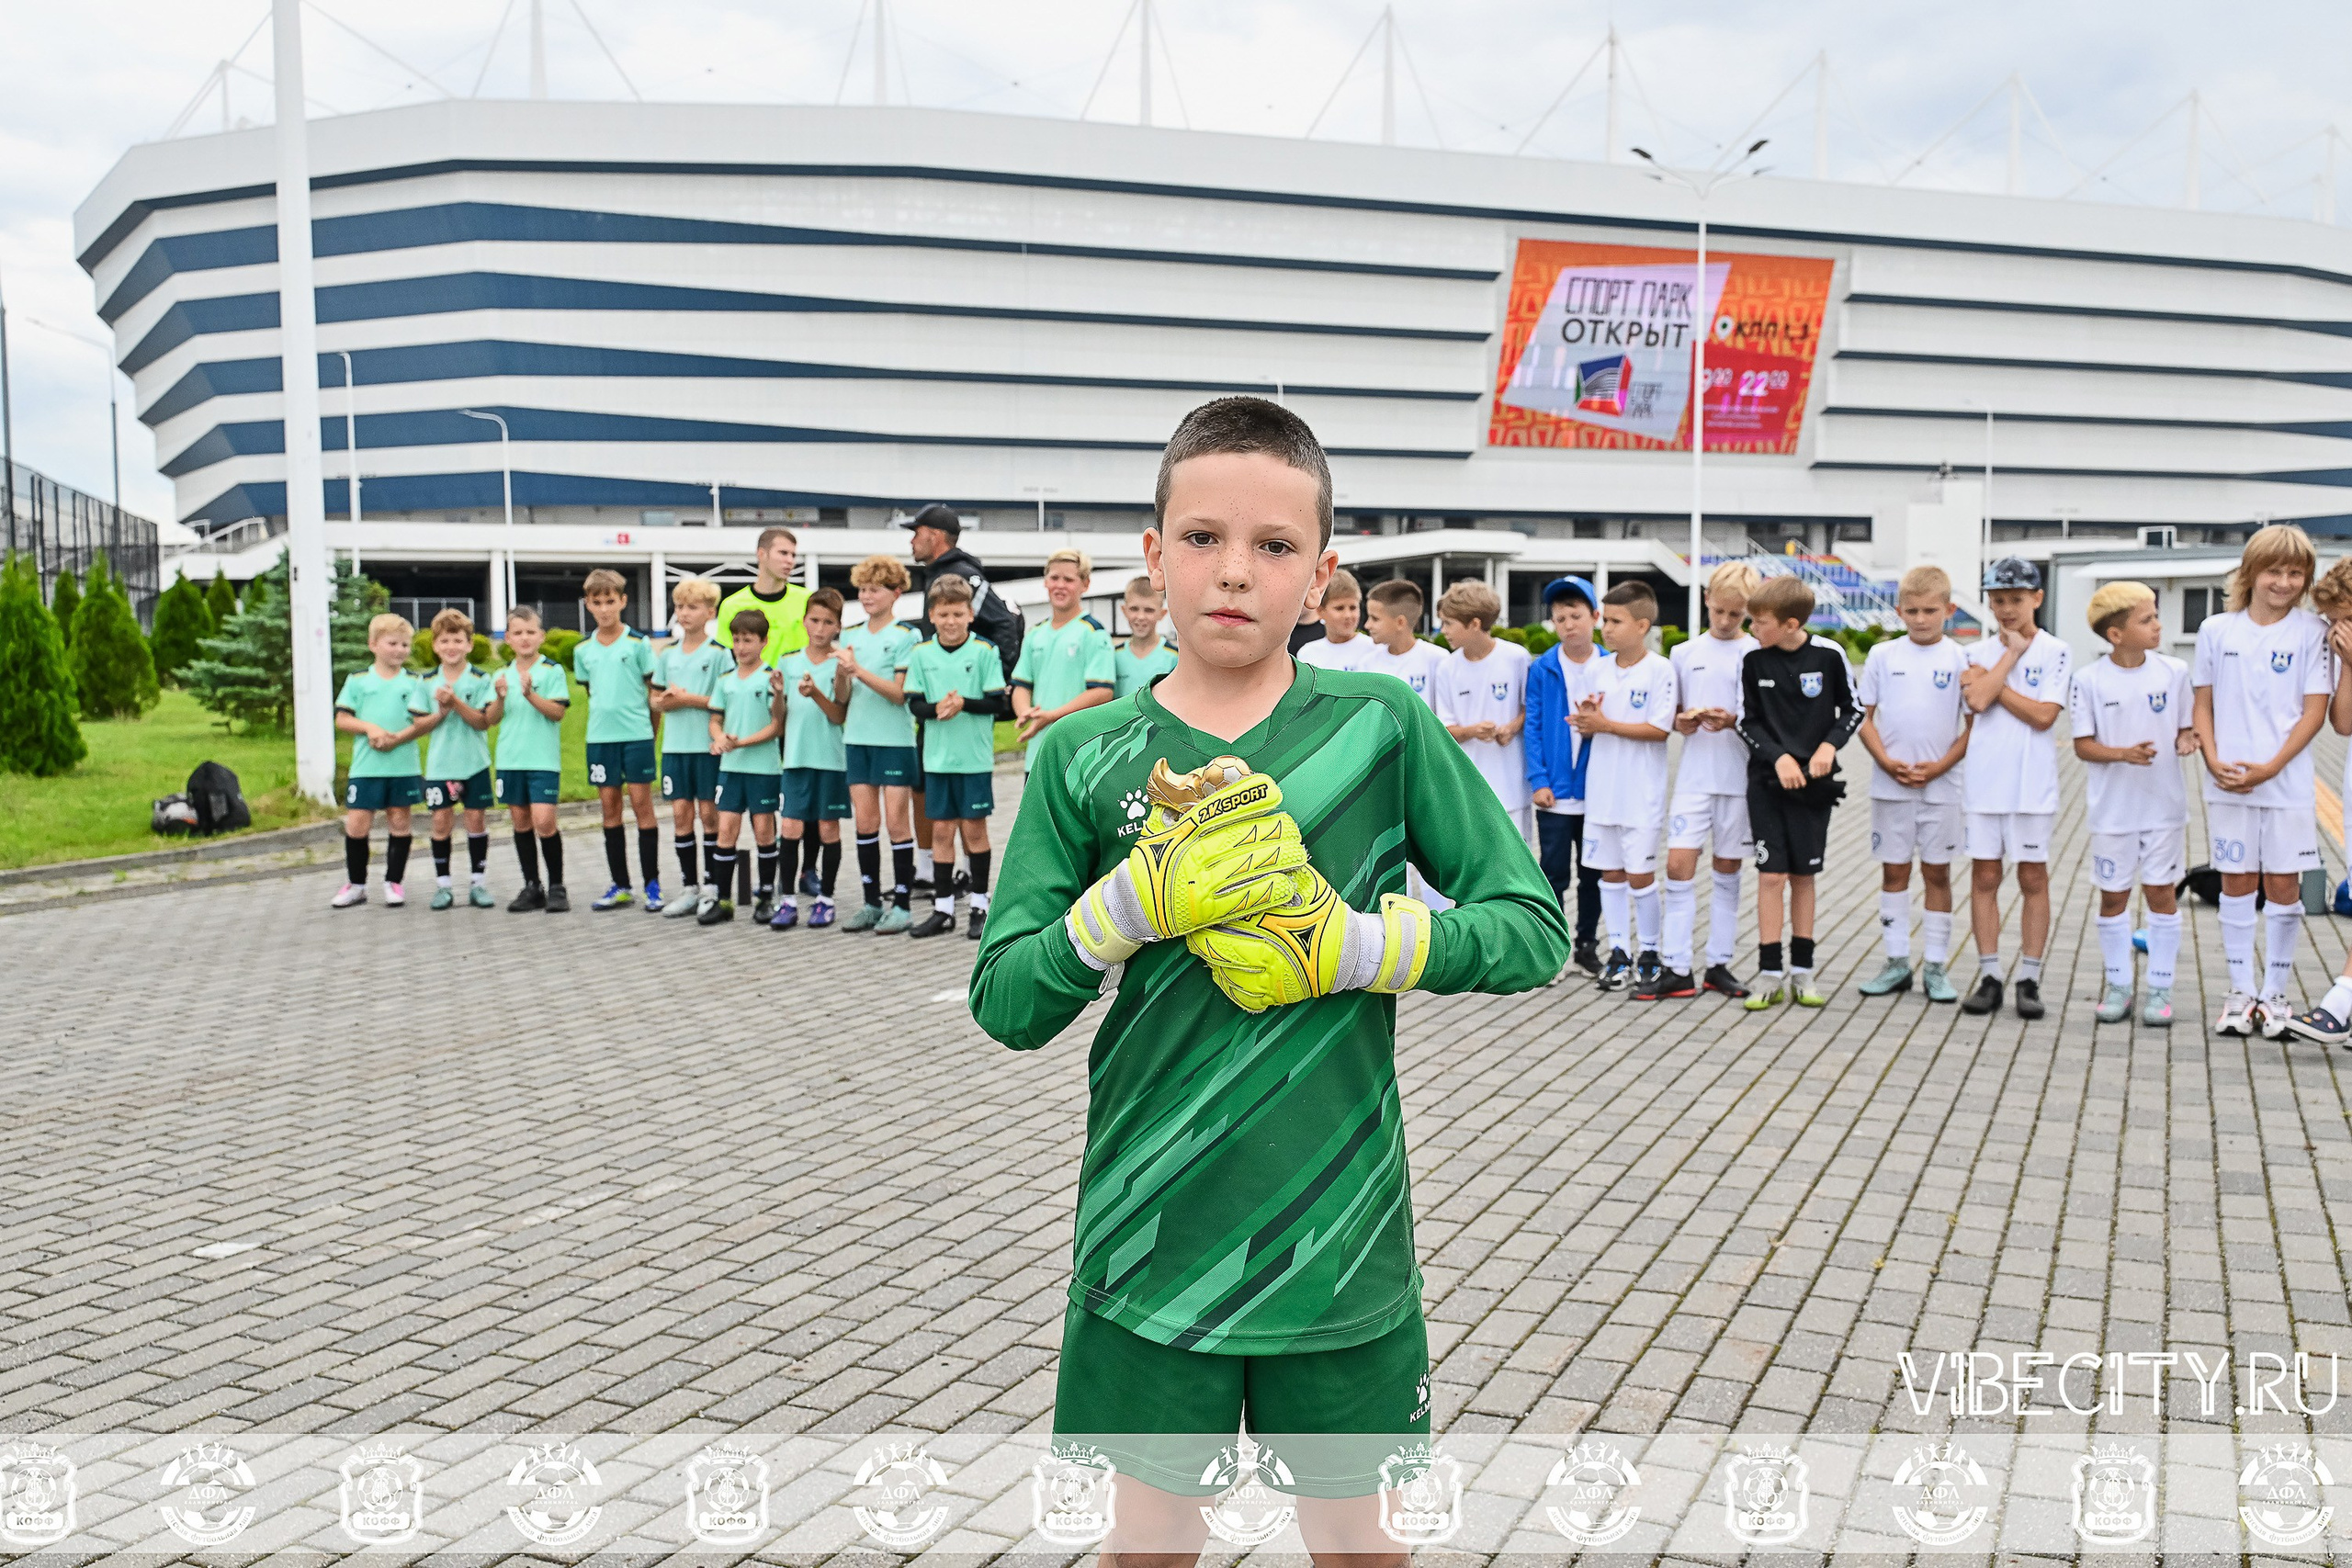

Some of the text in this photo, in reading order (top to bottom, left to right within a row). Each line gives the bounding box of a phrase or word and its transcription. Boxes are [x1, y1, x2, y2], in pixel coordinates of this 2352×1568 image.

[1565, 276, 1693, 319] СПОРТ ПАРК
[1561, 318, 1690, 348] ОТКРЫТ
